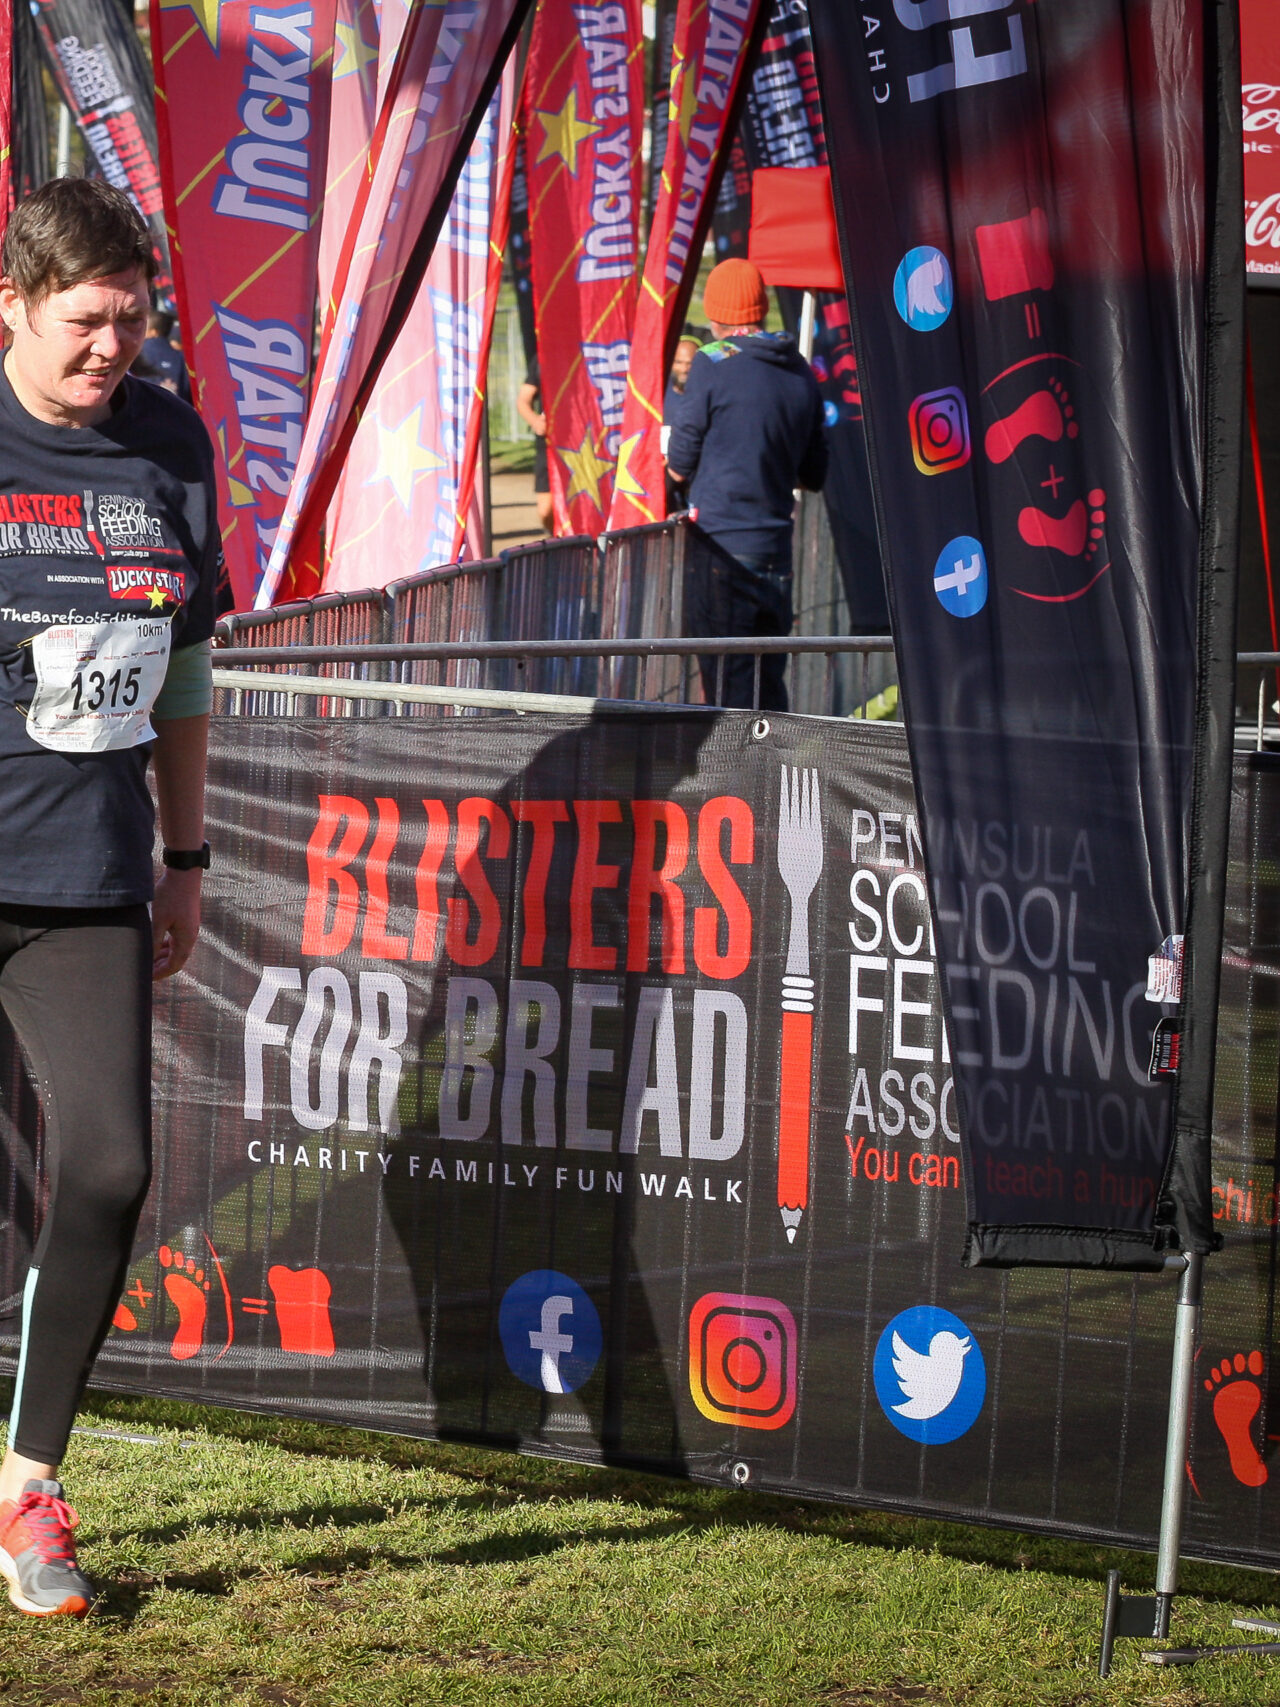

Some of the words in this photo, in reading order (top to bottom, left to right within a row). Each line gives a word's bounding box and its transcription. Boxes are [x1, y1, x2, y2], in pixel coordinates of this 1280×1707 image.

[98, 503, 148, 520] SCHOOL
[100, 517, 161, 537] FEEDING
[27, 523, 90, 550] BREAD
[106, 535, 165, 548] ASSOCIATION
[111, 569, 153, 592] LUCKY
[155, 572, 181, 600] STAR
[137, 623, 163, 638] 10km
[70, 667, 142, 711] 1315
[300, 793, 755, 980] BLISTERS
[847, 868, 1097, 974] SCHOOL
[243, 965, 409, 1135] FOR
[438, 976, 749, 1162] BREAD
[247, 1140, 393, 1175] CHARITY
[408, 1156, 540, 1188] FAMILY
[555, 1167, 624, 1194] FUN
[640, 1173, 744, 1204] WALK
[844, 1134, 901, 1183] You
[907, 1150, 962, 1190] can
